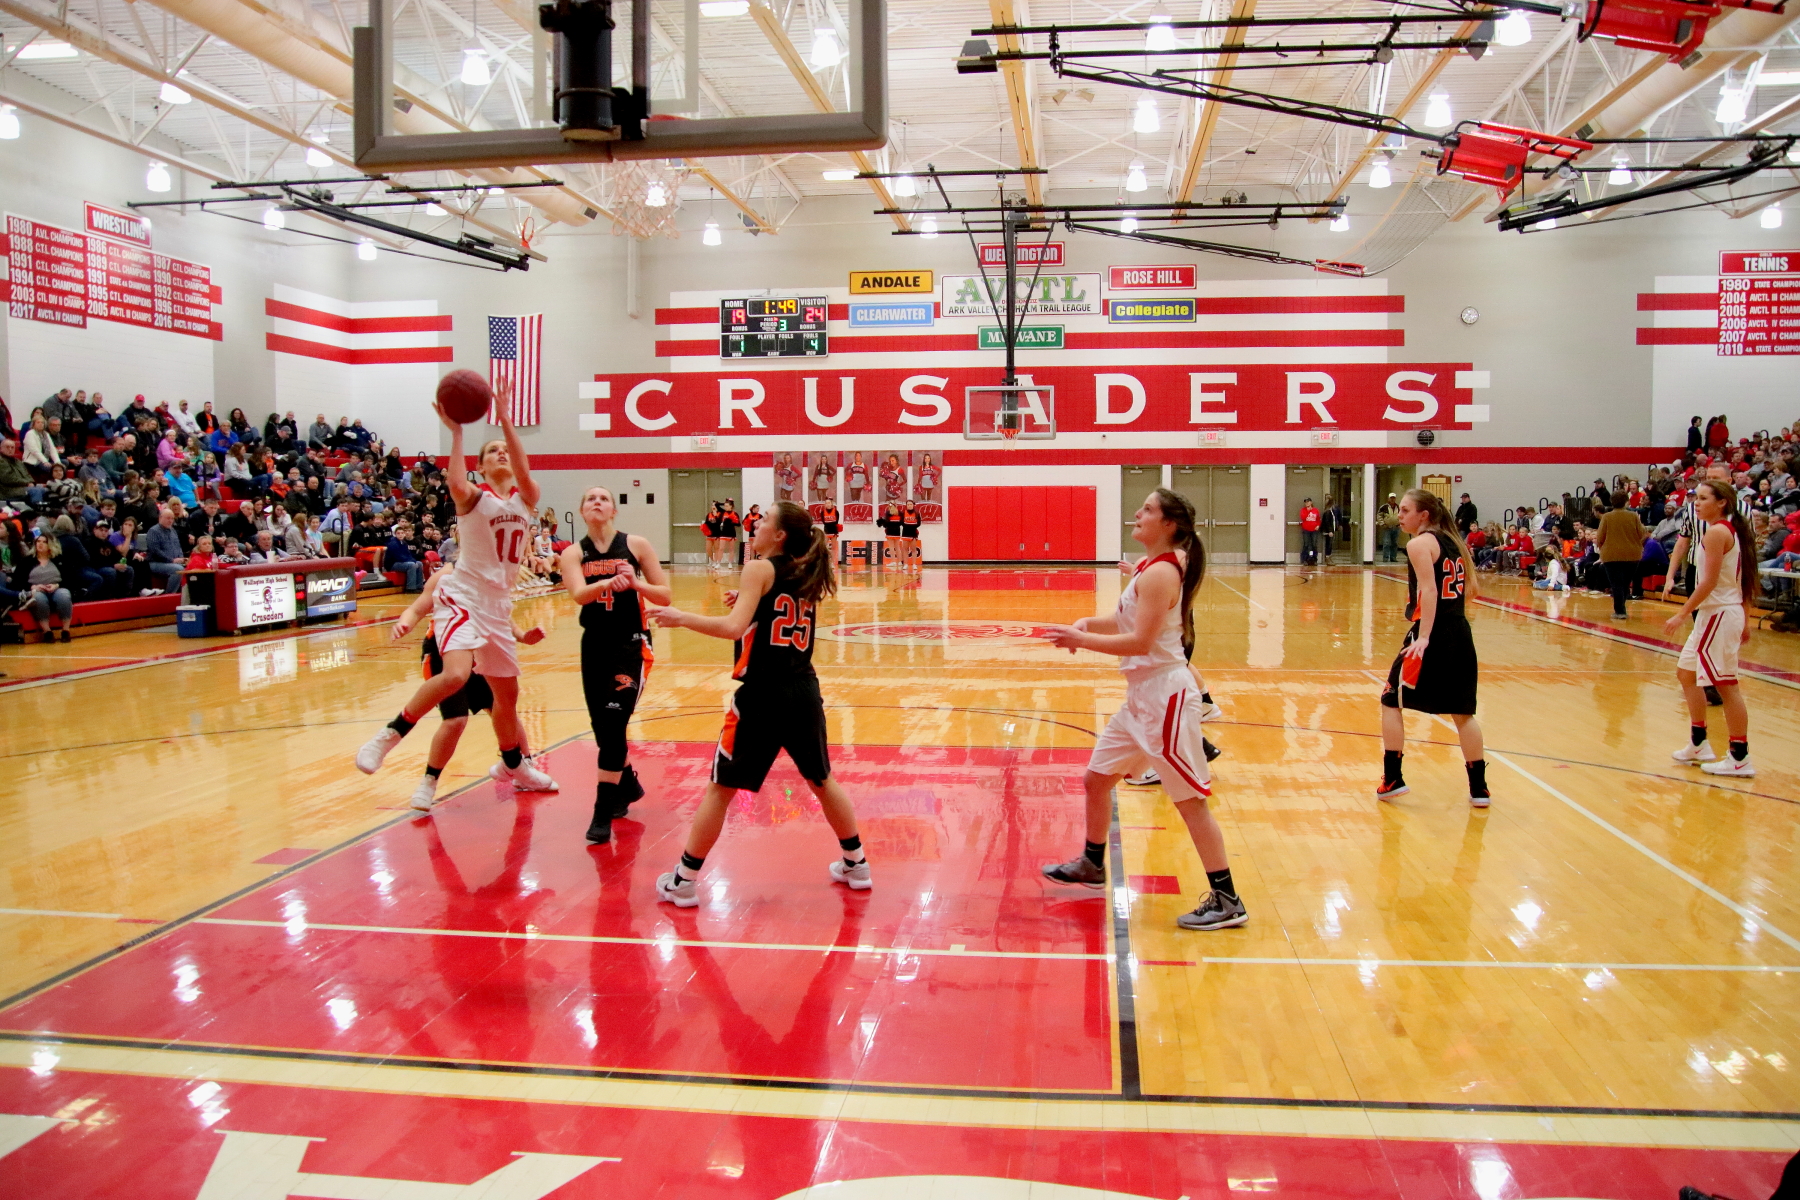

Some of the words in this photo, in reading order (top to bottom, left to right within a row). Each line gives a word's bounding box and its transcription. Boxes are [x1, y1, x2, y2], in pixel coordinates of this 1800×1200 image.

[8, 217, 33, 237] 1980
[50, 231, 84, 248] CHAMPIONS
[92, 210, 146, 241] WRESTLING
[8, 234, 34, 253] 1988
[50, 246, 84, 263] CHAMPIONS
[86, 238, 107, 255] 1986
[985, 247, 1058, 262] WEINGTON
[10, 251, 33, 270] 1991
[51, 263, 84, 280] CHAMPIONS
[86, 253, 108, 270] 1989
[152, 255, 171, 271] 1987
[1743, 256, 1788, 271] TENNIS
[10, 268, 34, 287] 1994
[52, 278, 85, 294] CHAMPIONS
[87, 268, 106, 286] 1991
[153, 269, 172, 286] 1990
[860, 276, 920, 288] ANDALE
[1124, 270, 1154, 284] ROSE
[1157, 270, 1182, 284] HILL
[88, 284, 108, 302] 1995
[154, 284, 172, 300] 1992
[955, 276, 1086, 304] AVCTL
[1720, 280, 1750, 291] 1980
[1754, 280, 1771, 288] STATE
[1772, 280, 1800, 288] CHAMPIO
[10, 286, 35, 304] 2003
[800, 298, 826, 306] VISITOR
[1720, 292, 1746, 304] 2004
[1750, 294, 1770, 302] AVCTL
[88, 300, 108, 317] 2005
[154, 298, 172, 314] 1996
[724, 300, 744, 308] HOME
[764, 300, 796, 314] 1:49
[948, 305, 965, 314] ARK
[997, 304, 1038, 314] CHHOLM
[1039, 304, 1060, 312] TRAIL
[1062, 303, 1091, 312] LEAGUE
[1116, 304, 1189, 316] Collegiate
[1720, 305, 1746, 317] 2005
[1750, 306, 1770, 314] AVCTL
[11, 302, 35, 320] 2017
[62, 312, 83, 324] CHAMPS
[154, 313, 172, 329] 2016
[732, 309, 746, 324] 19
[806, 306, 824, 323] 24
[856, 308, 926, 322] CLEARWATER
[780, 320, 786, 331] 3
[1720, 318, 1748, 330] 2006
[1748, 320, 1768, 328] AVCTL
[987, 330, 1057, 343] MVANE
[1719, 330, 1746, 342] 2007
[1747, 332, 1768, 340] AVCTL
[740, 341, 744, 352] 1
[810, 339, 818, 350] 4
[1718, 344, 1743, 355] 2010
[495, 528, 524, 564] 10
[581, 558, 628, 578] UGUS
[308, 577, 348, 593] IMPACT
[331, 594, 346, 602] BANK
[596, 589, 614, 611] 4
[252, 610, 284, 623] Crusaders
[770, 593, 813, 652] 25
